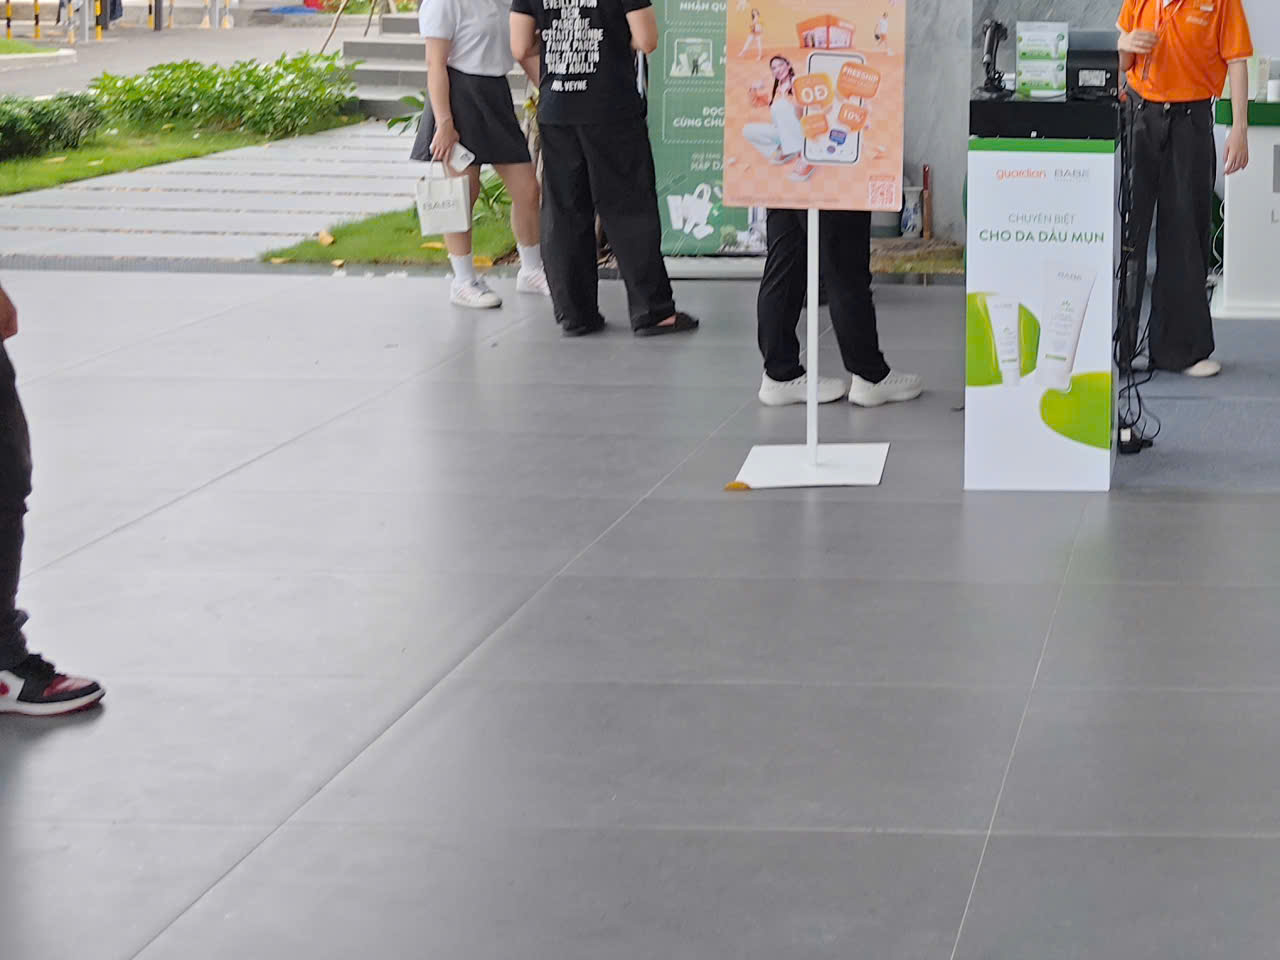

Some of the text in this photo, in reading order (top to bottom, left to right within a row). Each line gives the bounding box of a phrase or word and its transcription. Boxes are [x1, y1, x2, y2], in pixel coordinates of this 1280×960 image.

[711, 2, 727, 13] QU
[704, 117, 725, 128] CHU
[995, 168, 1047, 180] guardian
[979, 228, 1012, 242] CHO
[1016, 229, 1035, 242] DA
